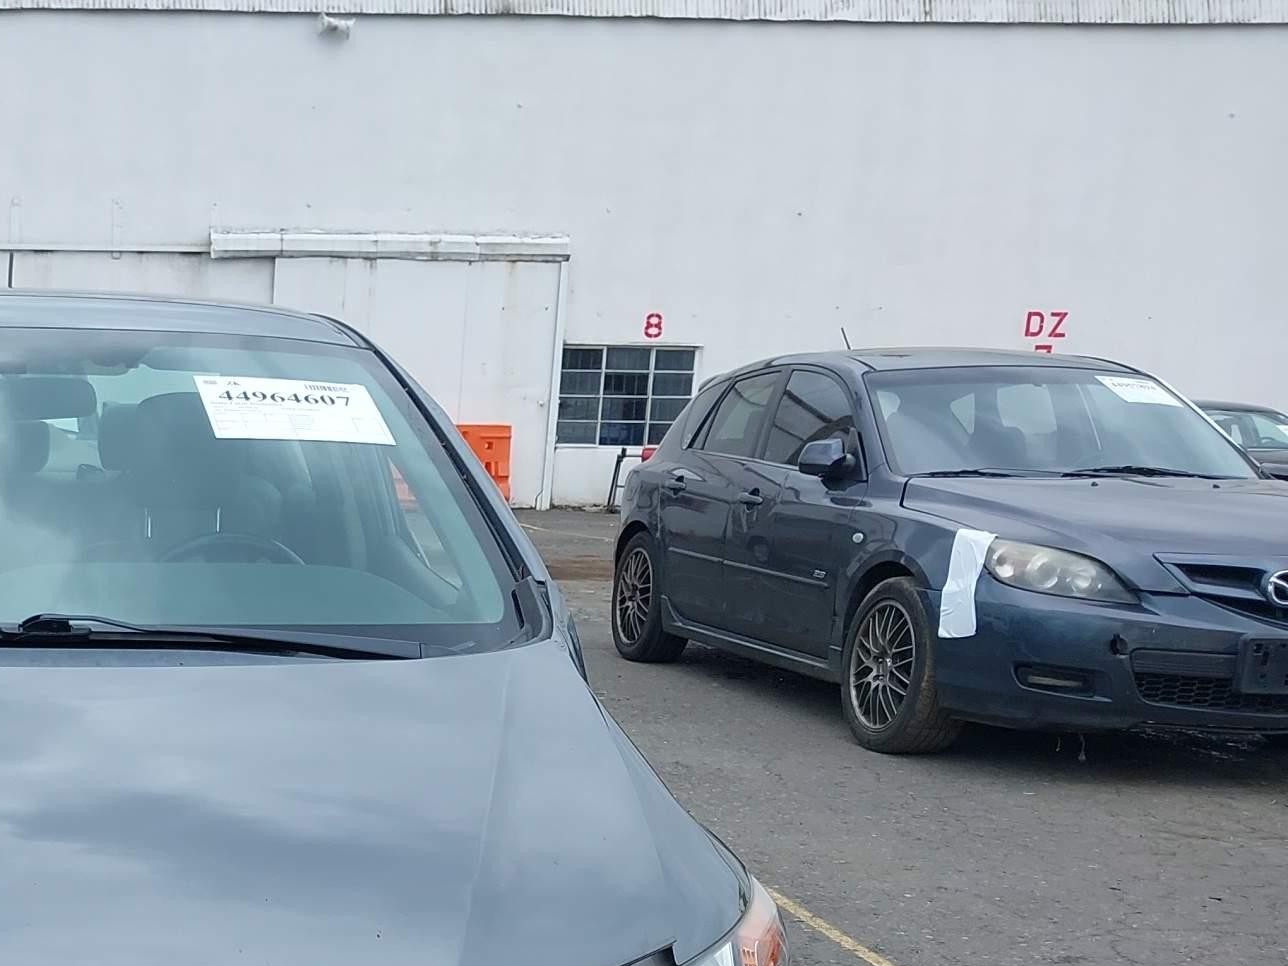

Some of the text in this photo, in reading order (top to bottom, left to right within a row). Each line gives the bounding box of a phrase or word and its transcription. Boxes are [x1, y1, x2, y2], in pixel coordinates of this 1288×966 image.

[644, 312, 663, 338] 8
[1024, 311, 1069, 338] DZ
[218, 390, 350, 407] 44964607
